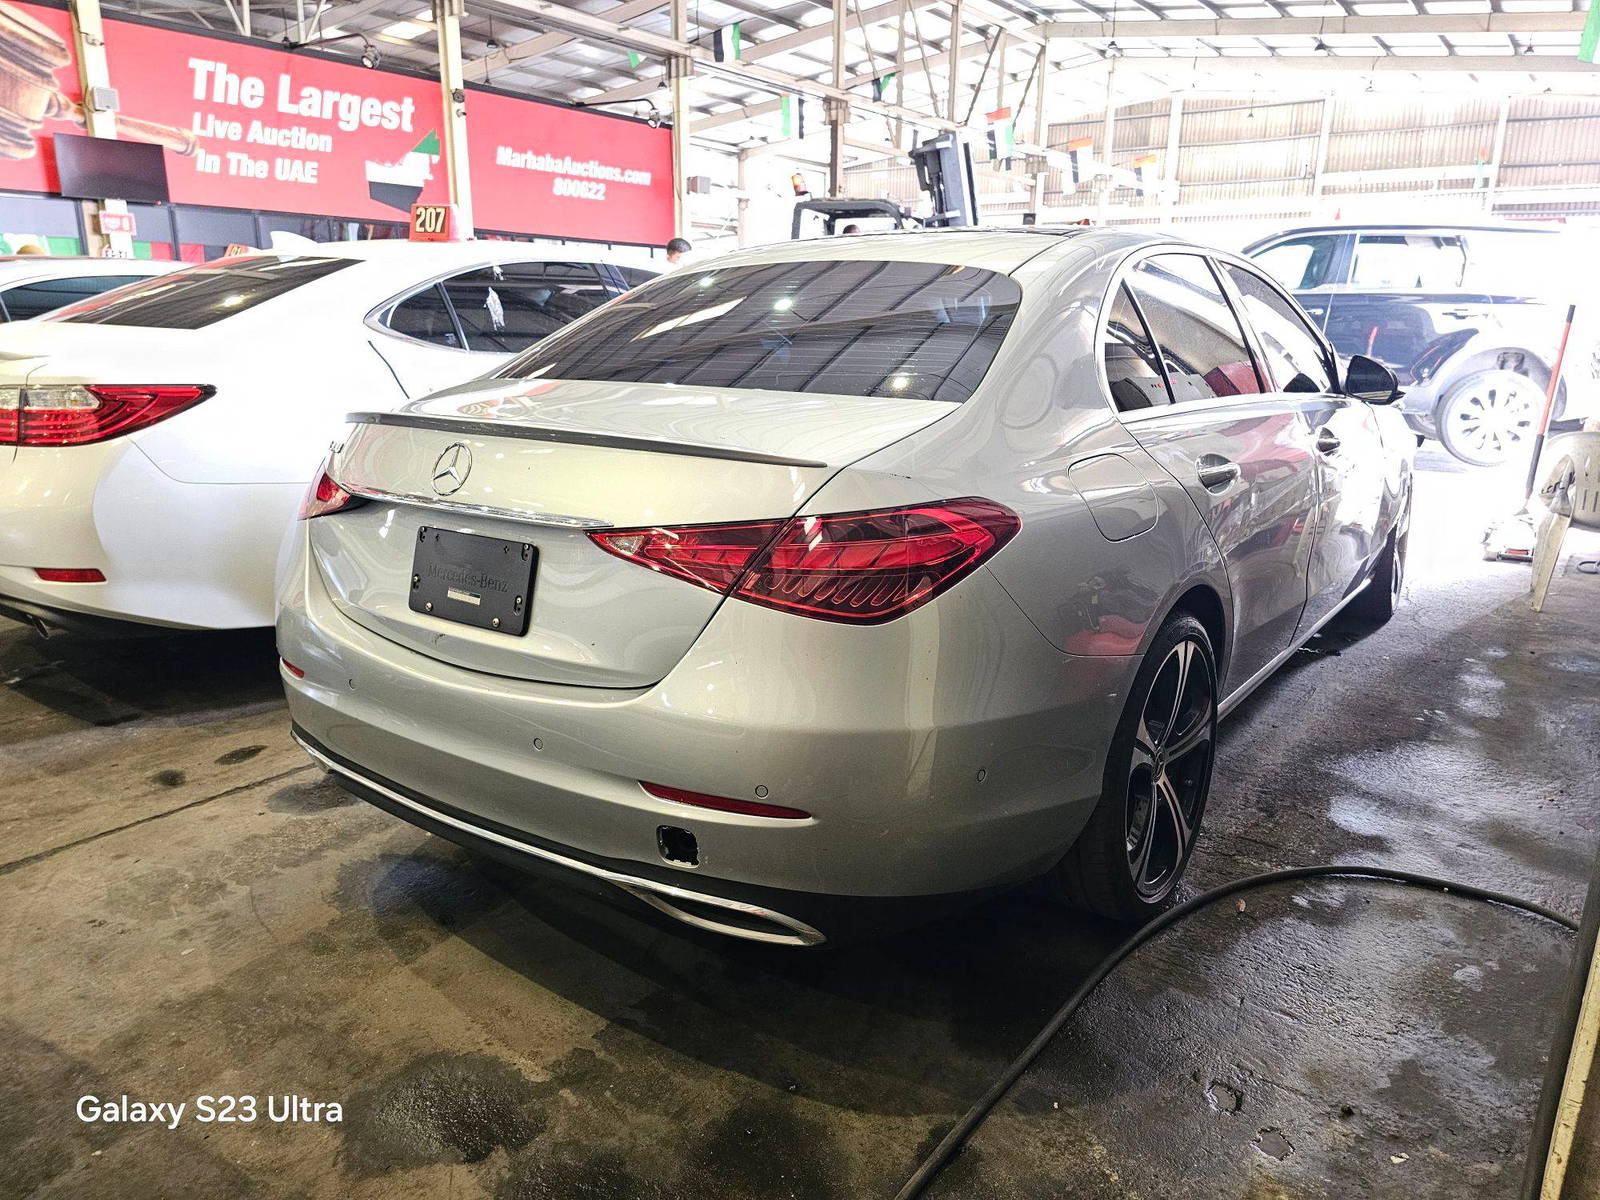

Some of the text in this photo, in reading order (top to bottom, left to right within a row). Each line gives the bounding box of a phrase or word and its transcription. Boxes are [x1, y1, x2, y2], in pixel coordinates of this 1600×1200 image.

[188, 57, 415, 133] The Largest
[192, 111, 333, 152] Live Auction
[195, 148, 318, 184] In The UAE
[496, 145, 652, 186] MarhabaAuctions.com
[553, 177, 606, 201] 800622
[415, 207, 446, 233] 207
[427, 563, 508, 592] Mercedes-Benz
